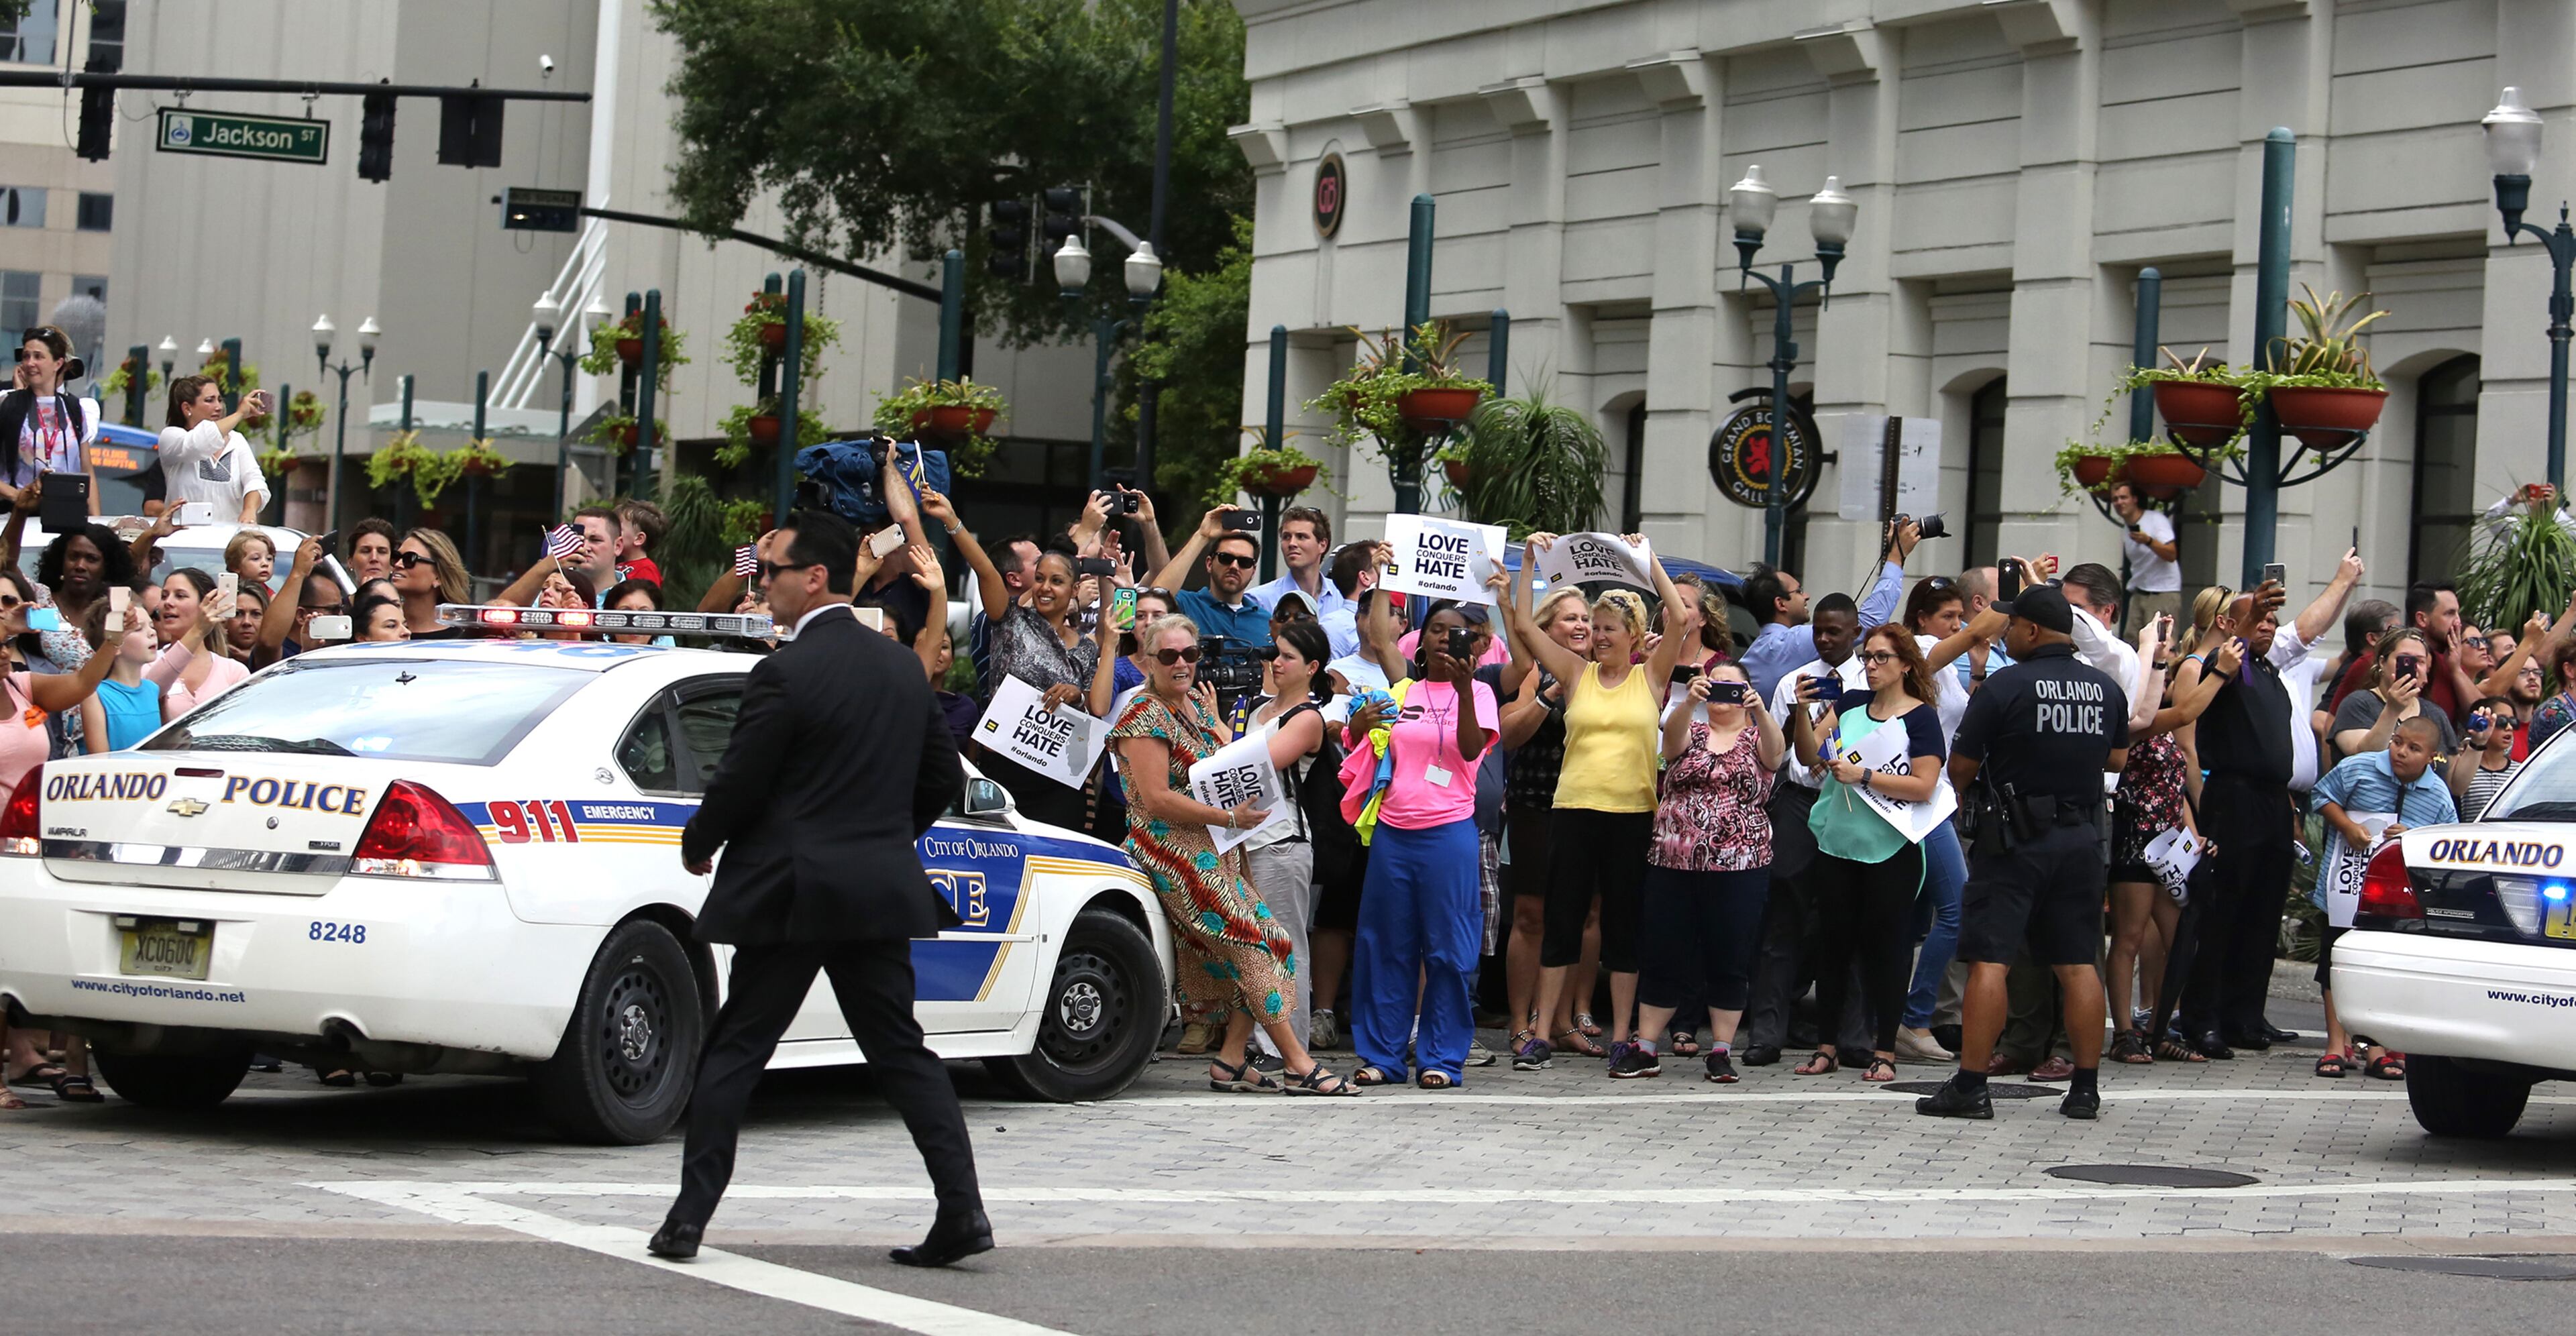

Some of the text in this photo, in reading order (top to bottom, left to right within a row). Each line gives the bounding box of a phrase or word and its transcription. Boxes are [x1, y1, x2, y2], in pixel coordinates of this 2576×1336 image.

[203, 122, 316, 149] Jackson ST
[1721, 416, 1752, 463] GRAND
[1416, 549, 1467, 563] CONQUERS
[1418, 533, 1469, 554] LOVE
[1568, 541, 1616, 557] LOVE
[1415, 558, 1466, 579] HATE
[1574, 558, 1624, 572] HATE
[1585, 570, 1623, 578] #orlando
[1417, 580, 1458, 592] #orlando
[2035, 679, 2104, 702] ORLANDO
[1019, 718, 1067, 744] CONQUERS
[1024, 704, 1075, 737] LOVE
[2036, 703, 2104, 736] POLICE
[1012, 725, 1063, 758] HATE
[1010, 745, 1048, 767] #orlando
[1889, 753, 1911, 776] LO
[1199, 779, 1214, 807] #orland
[1211, 770, 1238, 810] HATE
[1237, 763, 1264, 799] LOVE
[46, 772, 369, 818] ORLANDO POLICE
[488, 800, 657, 844] 911 EMERGENCY
[2429, 838, 2565, 870] ORLANDO
[2339, 846, 2355, 895] LOVE
[2352, 851, 2361, 896] CONQUER
[309, 921, 367, 944] 8248
[71, 979, 246, 1003] www.cityoforlando.net
[2487, 990, 2576, 1008] www.cityof
